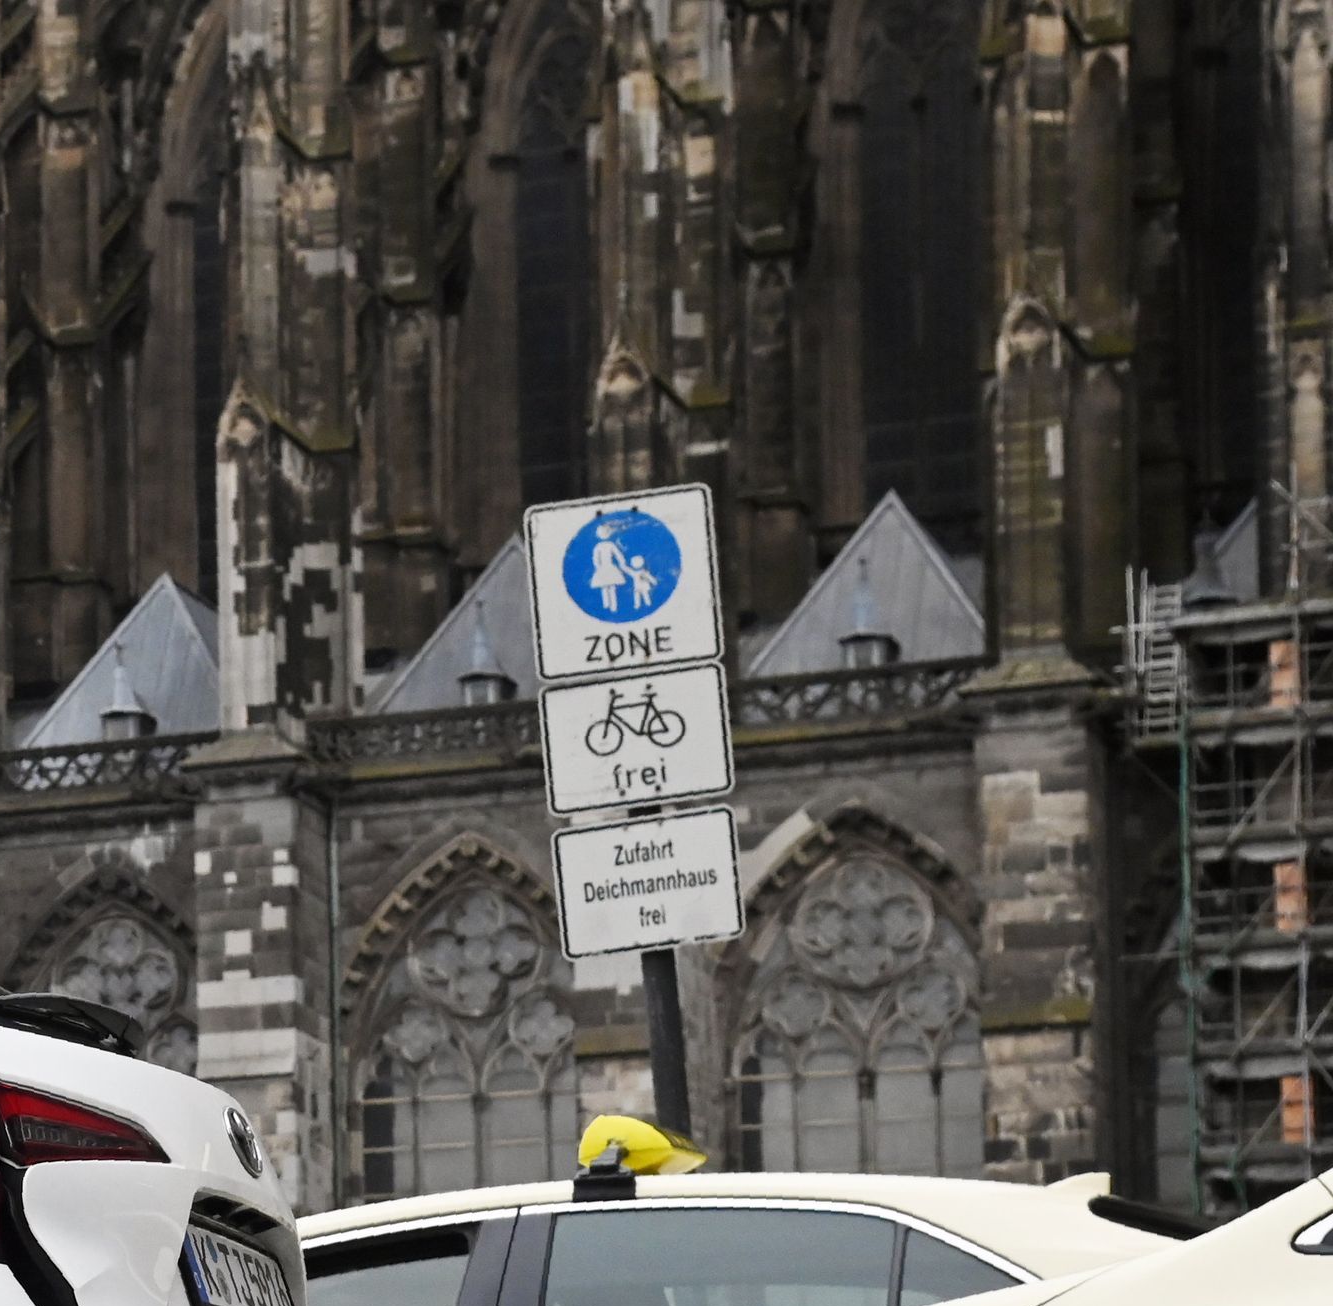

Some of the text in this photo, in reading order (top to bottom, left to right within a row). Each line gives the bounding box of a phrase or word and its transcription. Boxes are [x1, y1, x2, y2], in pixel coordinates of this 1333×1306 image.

[584, 626, 673, 662] ZONE
[613, 757, 666, 790] frei
[614, 839, 674, 866] Zufahrt
[584, 868, 718, 903] Deichmannhaus
[639, 904, 667, 927] frei
